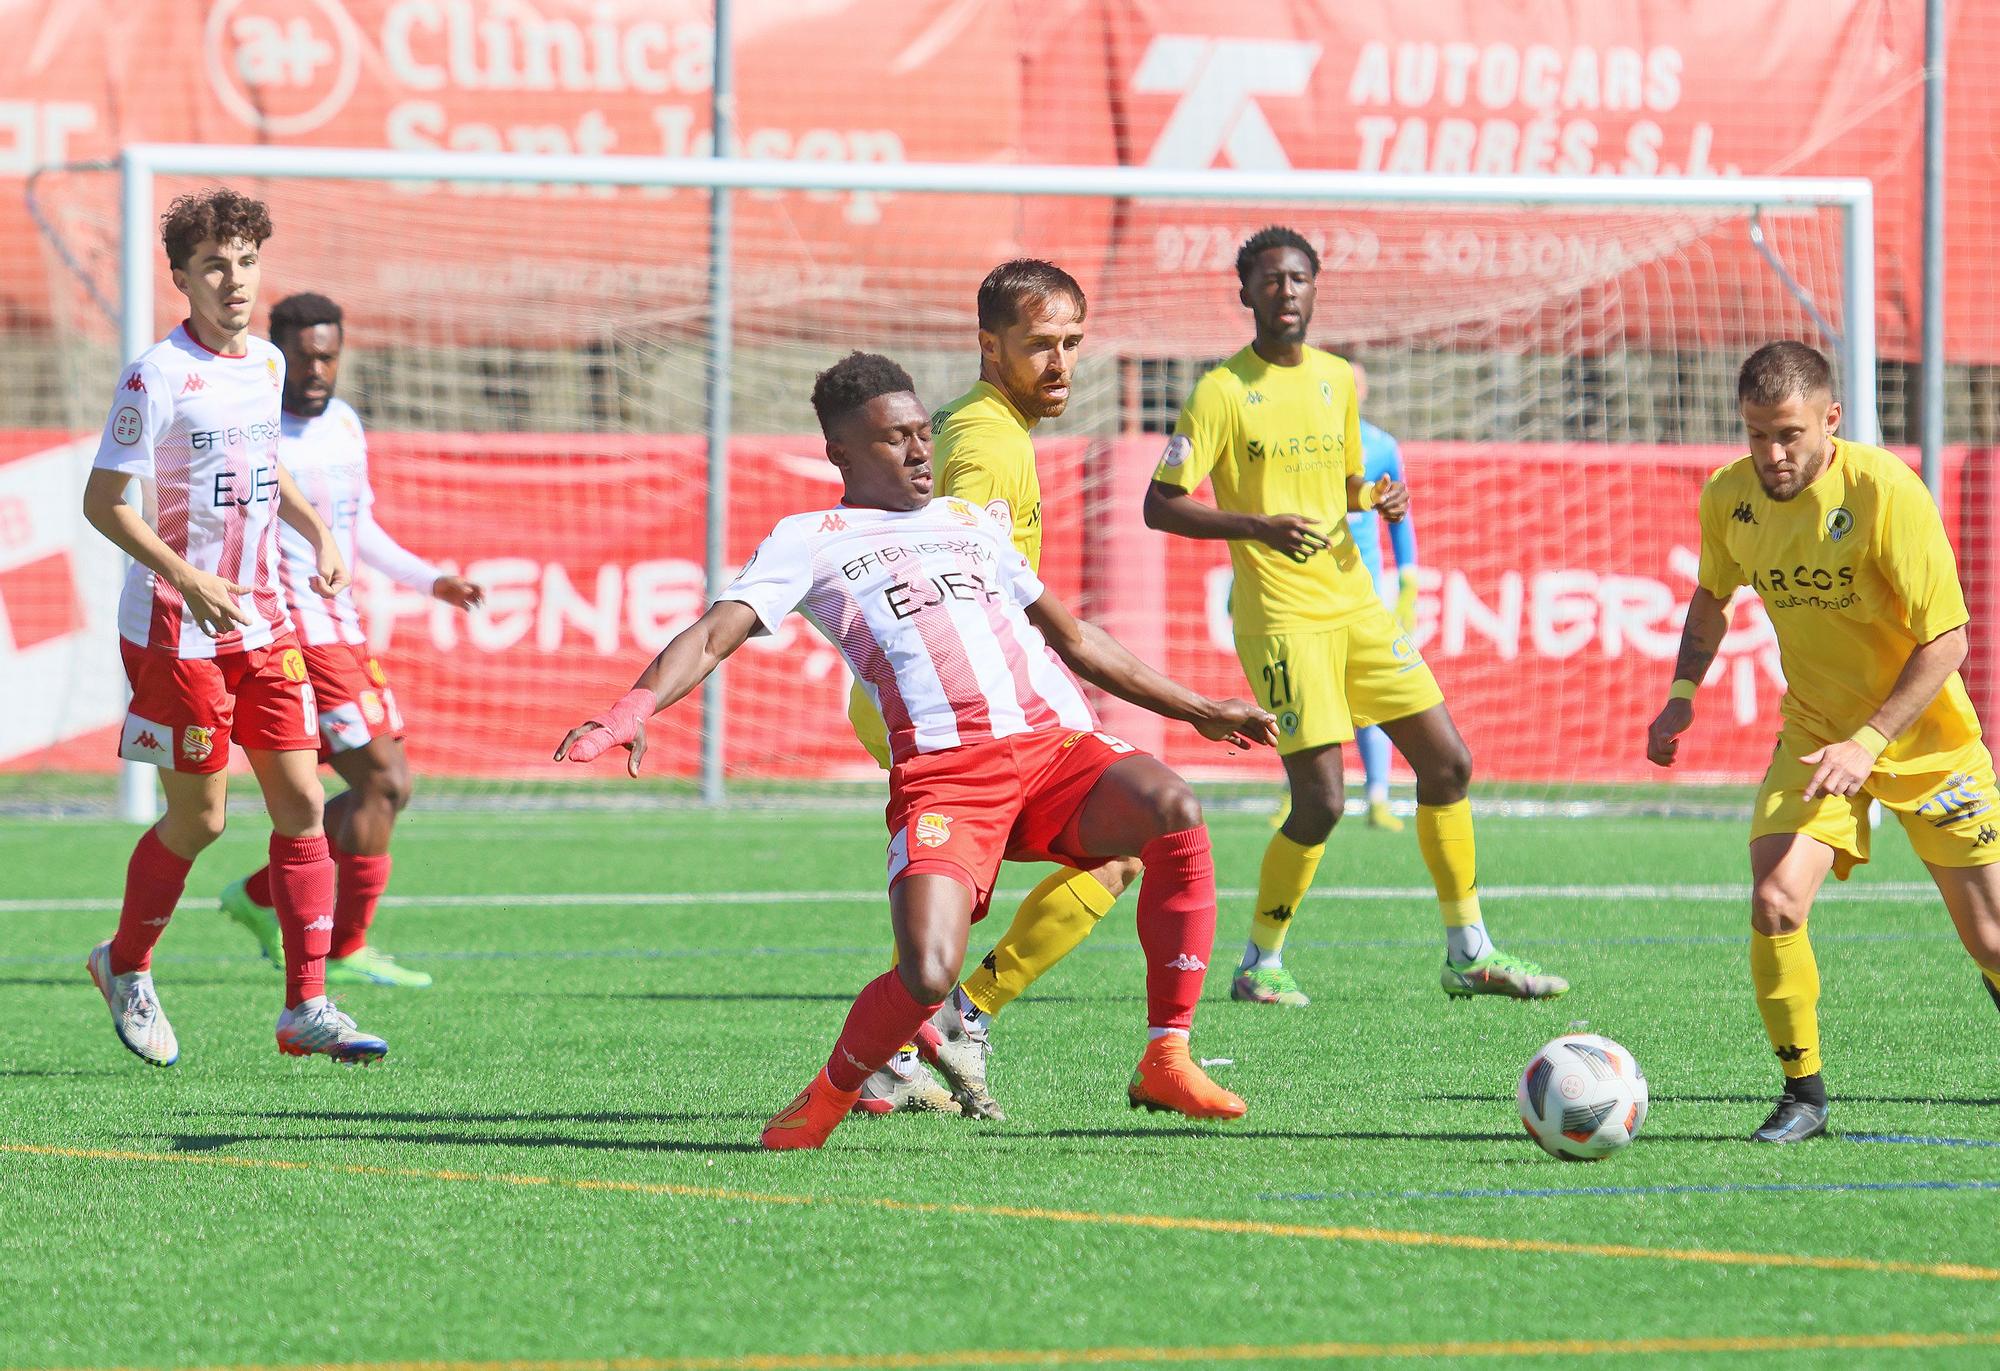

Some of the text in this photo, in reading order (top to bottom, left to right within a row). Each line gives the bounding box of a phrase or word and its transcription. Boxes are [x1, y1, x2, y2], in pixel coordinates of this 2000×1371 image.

[1351, 40, 1685, 113] AUTOCARS
[1752, 565, 1855, 592] ARCOS
[1263, 660, 1291, 709] 27
